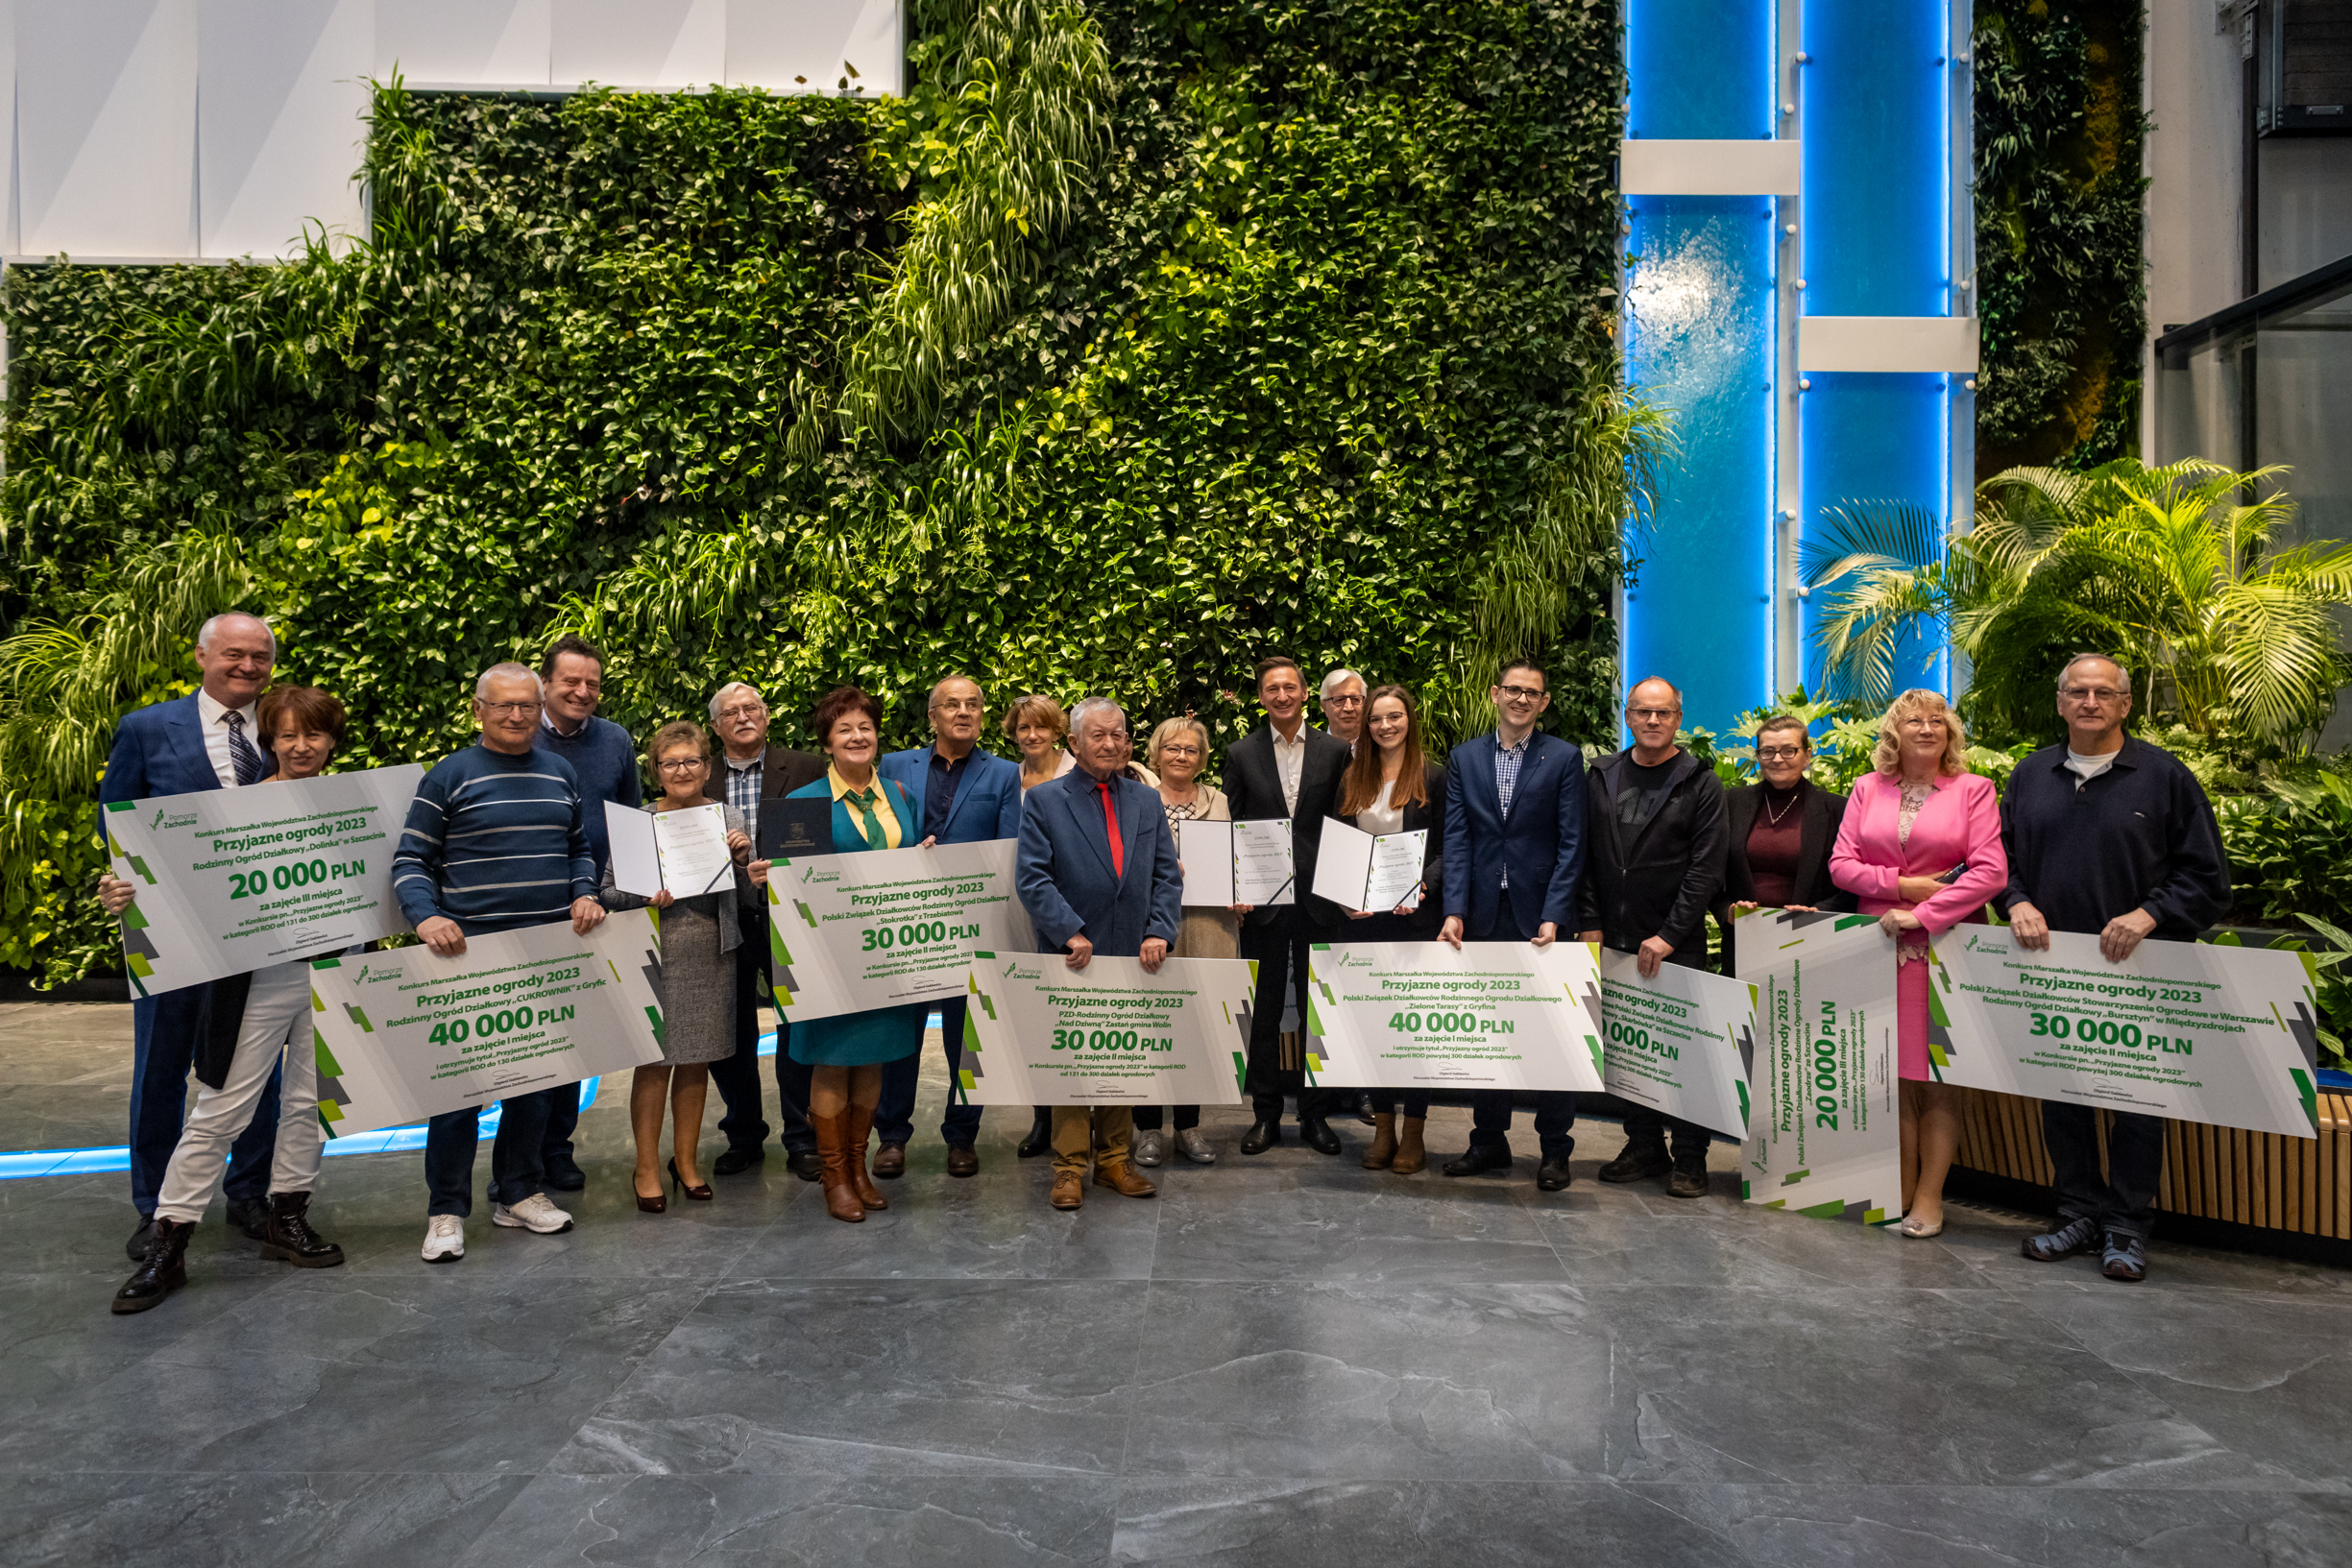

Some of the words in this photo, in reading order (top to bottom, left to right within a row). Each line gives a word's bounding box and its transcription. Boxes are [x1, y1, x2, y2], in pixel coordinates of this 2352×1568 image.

[163, 818, 197, 829] Zachodnie
[195, 830, 225, 838] Konkurs
[227, 823, 261, 833] Marszałka
[261, 817, 307, 828] Województwa
[307, 806, 378, 821] Zachodniopomorskiego
[214, 832, 284, 853] Przyjazne
[286, 822, 333, 842] ogrody
[335, 817, 366, 832] 2023
[193, 858, 234, 871] Rodzinny
[236, 852, 262, 864] Ogród
[263, 846, 305, 858] Działkowy
[351, 831, 386, 843] Szczecinie
[230, 870, 267, 899] 20
[274, 858, 327, 890] 000
[330, 859, 365, 880] PLN
[272, 896, 302, 908] zajęcie
[302, 893, 310, 902] III
[312, 888, 343, 901] miejsca
[852, 892, 911, 906] Przyjazne
[912, 885, 955, 901] ogrody
[957, 881, 983, 894] 2023
[822, 912, 844, 922] Polski
[845, 909, 875, 919] Związek
[876, 905, 922, 915] Działkowców
[923, 902, 955, 910] Rodzinny
[955, 898, 976, 907] Ogród
[977, 895, 1010, 904] Działkowy
[923, 910, 963, 919] Trzebiatowa
[861, 928, 893, 951] 30
[900, 922, 945, 946] 000
[949, 924, 980, 940] PLN
[1976, 947, 2007, 955] Zachodnie
[368, 973, 401, 983] Zachodnie
[374, 967, 402, 976] Pomorze
[1382, 979, 1441, 992] Przyjazne
[1443, 979, 1488, 992] ogrody
[1490, 980, 1520, 990] 2023
[417, 986, 491, 1008] Przyjazne
[494, 974, 545, 995] ogrody
[546, 967, 580, 983] 2023
[1515, 995, 1562, 1003] Działkowego
[2020, 974, 2094, 992] Przyjazne
[2097, 984, 2157, 1001] ogrody
[2160, 988, 2201, 1003] 2023
[387, 1014, 432, 1028] Rodzinny
[434, 1005, 464, 1019] Ogród
[466, 998, 512, 1013] Działkowy
[582, 978, 607, 990] Gryfic
[1048, 995, 1108, 1008] Przyjazne
[1110, 997, 1153, 1010] ogrody
[1154, 998, 1183, 1008] 2023
[1059, 1011, 1111, 1020] PZD-Rodzinny
[1134, 1012, 1170, 1021] Działkowy
[1625, 995, 1661, 1012] ogrody
[1661, 1002, 1686, 1018] 2023
[1778, 990, 1788, 1021] 2023
[1794, 998, 1803, 1026] Ogrody
[1960, 983, 1984, 993] Polski
[1986, 986, 2022, 997] Związek
[2024, 991, 2081, 1003] Działkowców
[2082, 998, 2154, 1012] Stowarzyszenie
[2157, 1006, 2209, 1018] Ogrodowe
[2219, 1013, 2274, 1025] Warszawie
[1983, 996, 2024, 1009] Rodzinny
[2025, 1001, 2052, 1011] Ogród
[2055, 1004, 2102, 1018] Działkowy
[2167, 1018, 2245, 1033] Międzyzdrojach
[429, 1020, 469, 1046] 40
[476, 1006, 533, 1037] 000
[538, 1004, 574, 1025] PLN
[1389, 1013, 1421, 1032] 40
[1427, 1013, 1476, 1032] 000
[1480, 1020, 1514, 1033] PLN
[1822, 1001, 1835, 1036] PLN
[474, 1039, 506, 1051] zajęcie
[512, 1031, 546, 1043] miejsca
[1051, 1030, 1084, 1050] 30
[1090, 1030, 1137, 1050] 000
[1140, 1038, 1172, 1051] PLN
[1424, 1035, 1452, 1044] zajęcie
[1457, 1035, 1487, 1044] miejsca
[1611, 1023, 1648, 1049] 000
[1651, 1040, 1678, 1061] PLN
[1663, 1027, 1691, 1041] Szczecina
[1778, 1023, 1792, 1069] ogrody
[2030, 1013, 2069, 1039] 30
[2078, 1019, 2141, 1048] 000
[2147, 1034, 2192, 1055] PLN
[1806, 1059, 1811, 1068] ze
[1815, 1040, 1836, 1090] 000
[2073, 1045, 2107, 1055] zajęcie
[2118, 1050, 2156, 1062] miejsca
[2026, 1057, 2058, 1068] kategorii
[2077, 1066, 2107, 1075] powyżej
[2124, 1072, 2152, 1081] działek
[2153, 1076, 2202, 1088] ogrodowych
[1780, 1071, 1793, 1132] Przyjazne
[1816, 1097, 1837, 1130] 20
[1796, 1113, 1806, 1143] Związek
